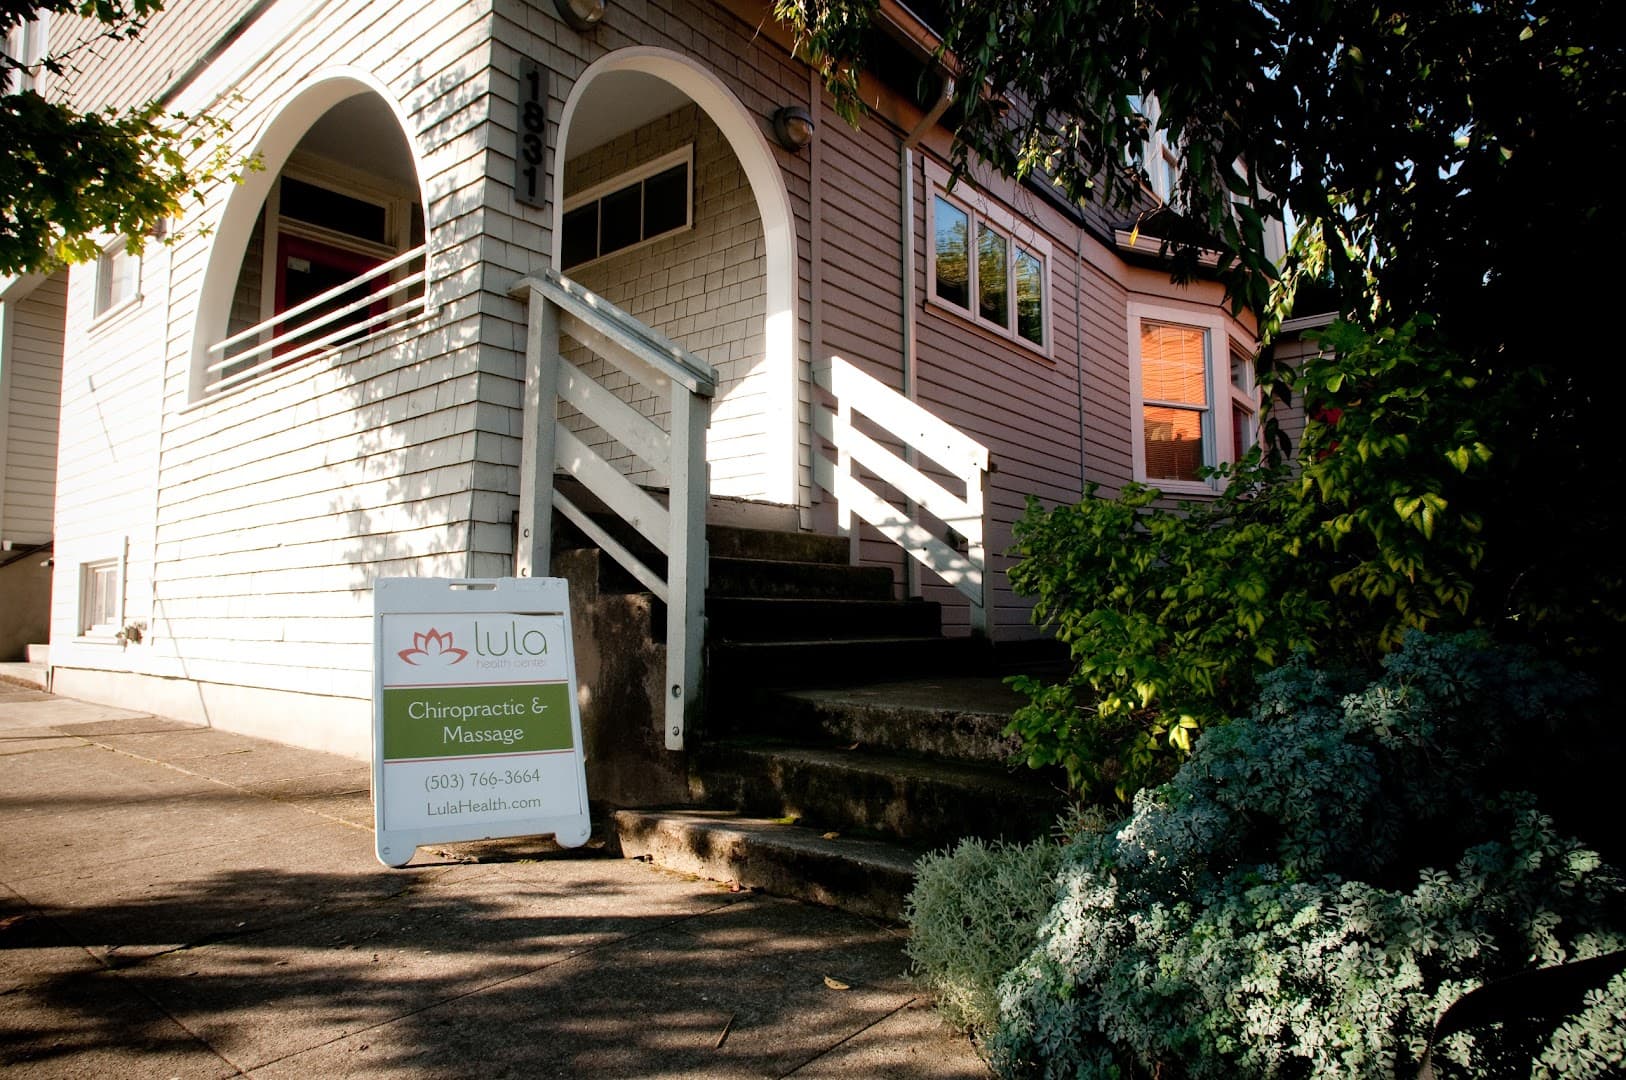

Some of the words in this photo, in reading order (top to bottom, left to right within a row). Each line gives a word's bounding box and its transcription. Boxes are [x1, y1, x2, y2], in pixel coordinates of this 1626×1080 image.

[523, 70, 545, 197] 1831
[474, 620, 548, 657] lula
[476, 659, 511, 669] health
[513, 657, 548, 668] center
[408, 698, 526, 721] Chiropractic
[531, 697, 548, 714] &
[443, 725, 525, 745] Massage
[424, 773, 465, 792] (503)
[469, 768, 541, 788] 766-3664
[427, 796, 542, 817] LulaHealth.com
